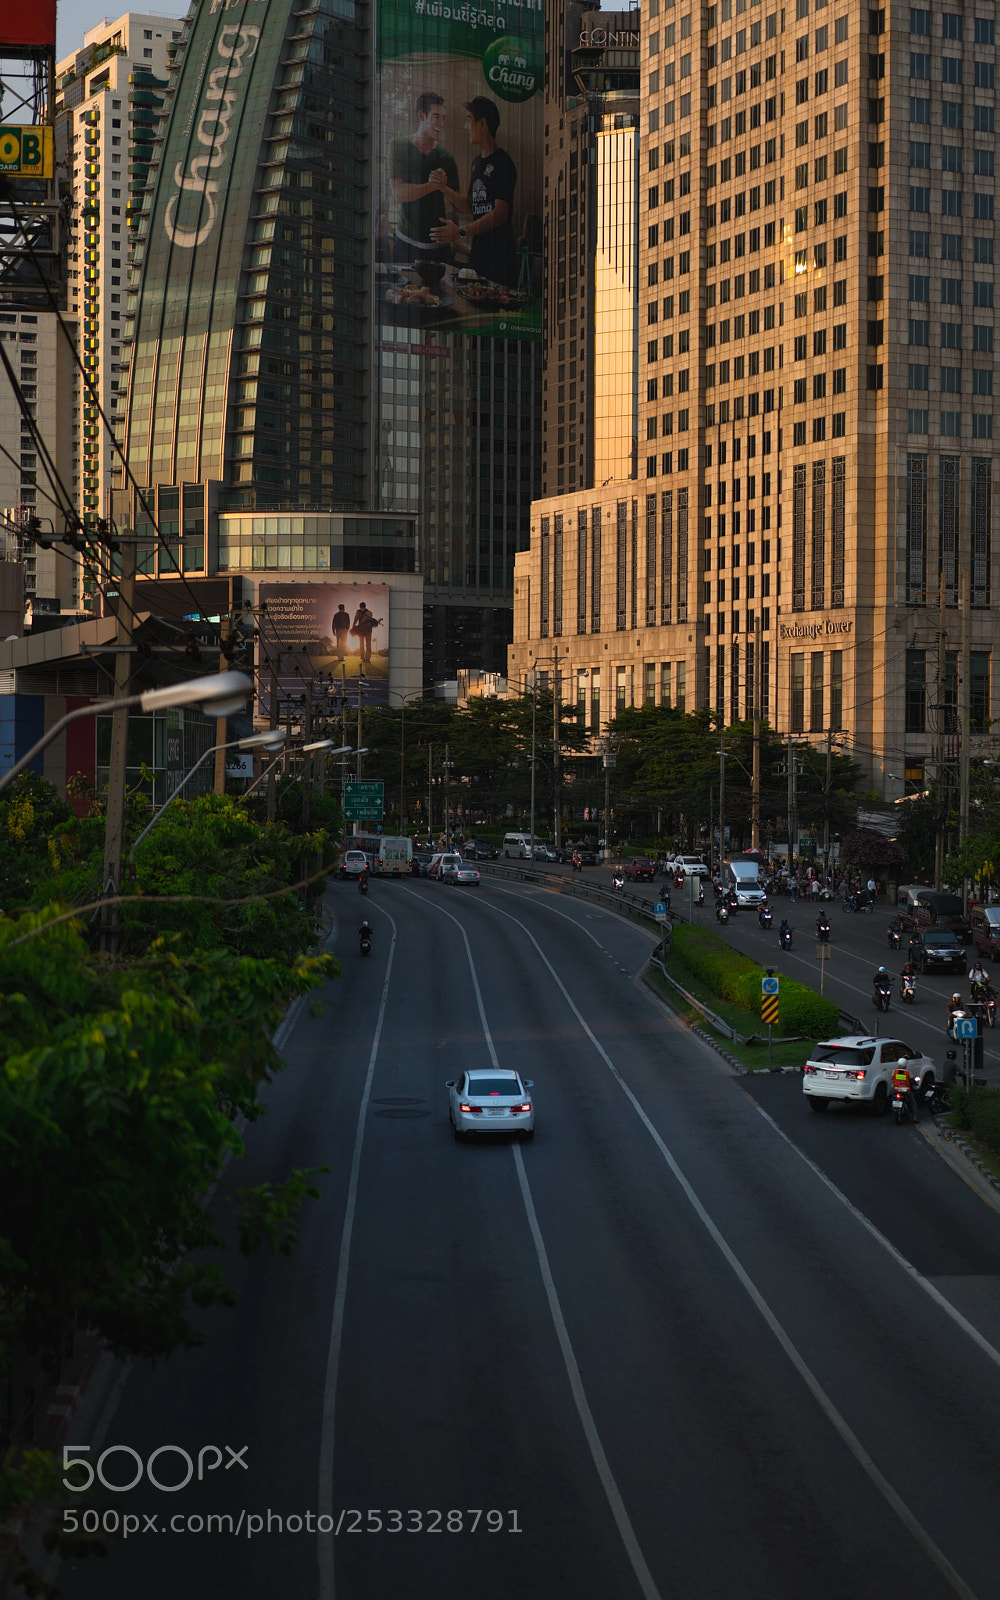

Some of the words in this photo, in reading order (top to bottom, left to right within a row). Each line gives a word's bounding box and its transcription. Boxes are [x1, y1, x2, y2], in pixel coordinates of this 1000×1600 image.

[488, 65, 536, 91] Chang
[165, 23, 261, 248] Chang
[780, 621, 823, 640] Exchange
[823, 618, 852, 635] Tower
